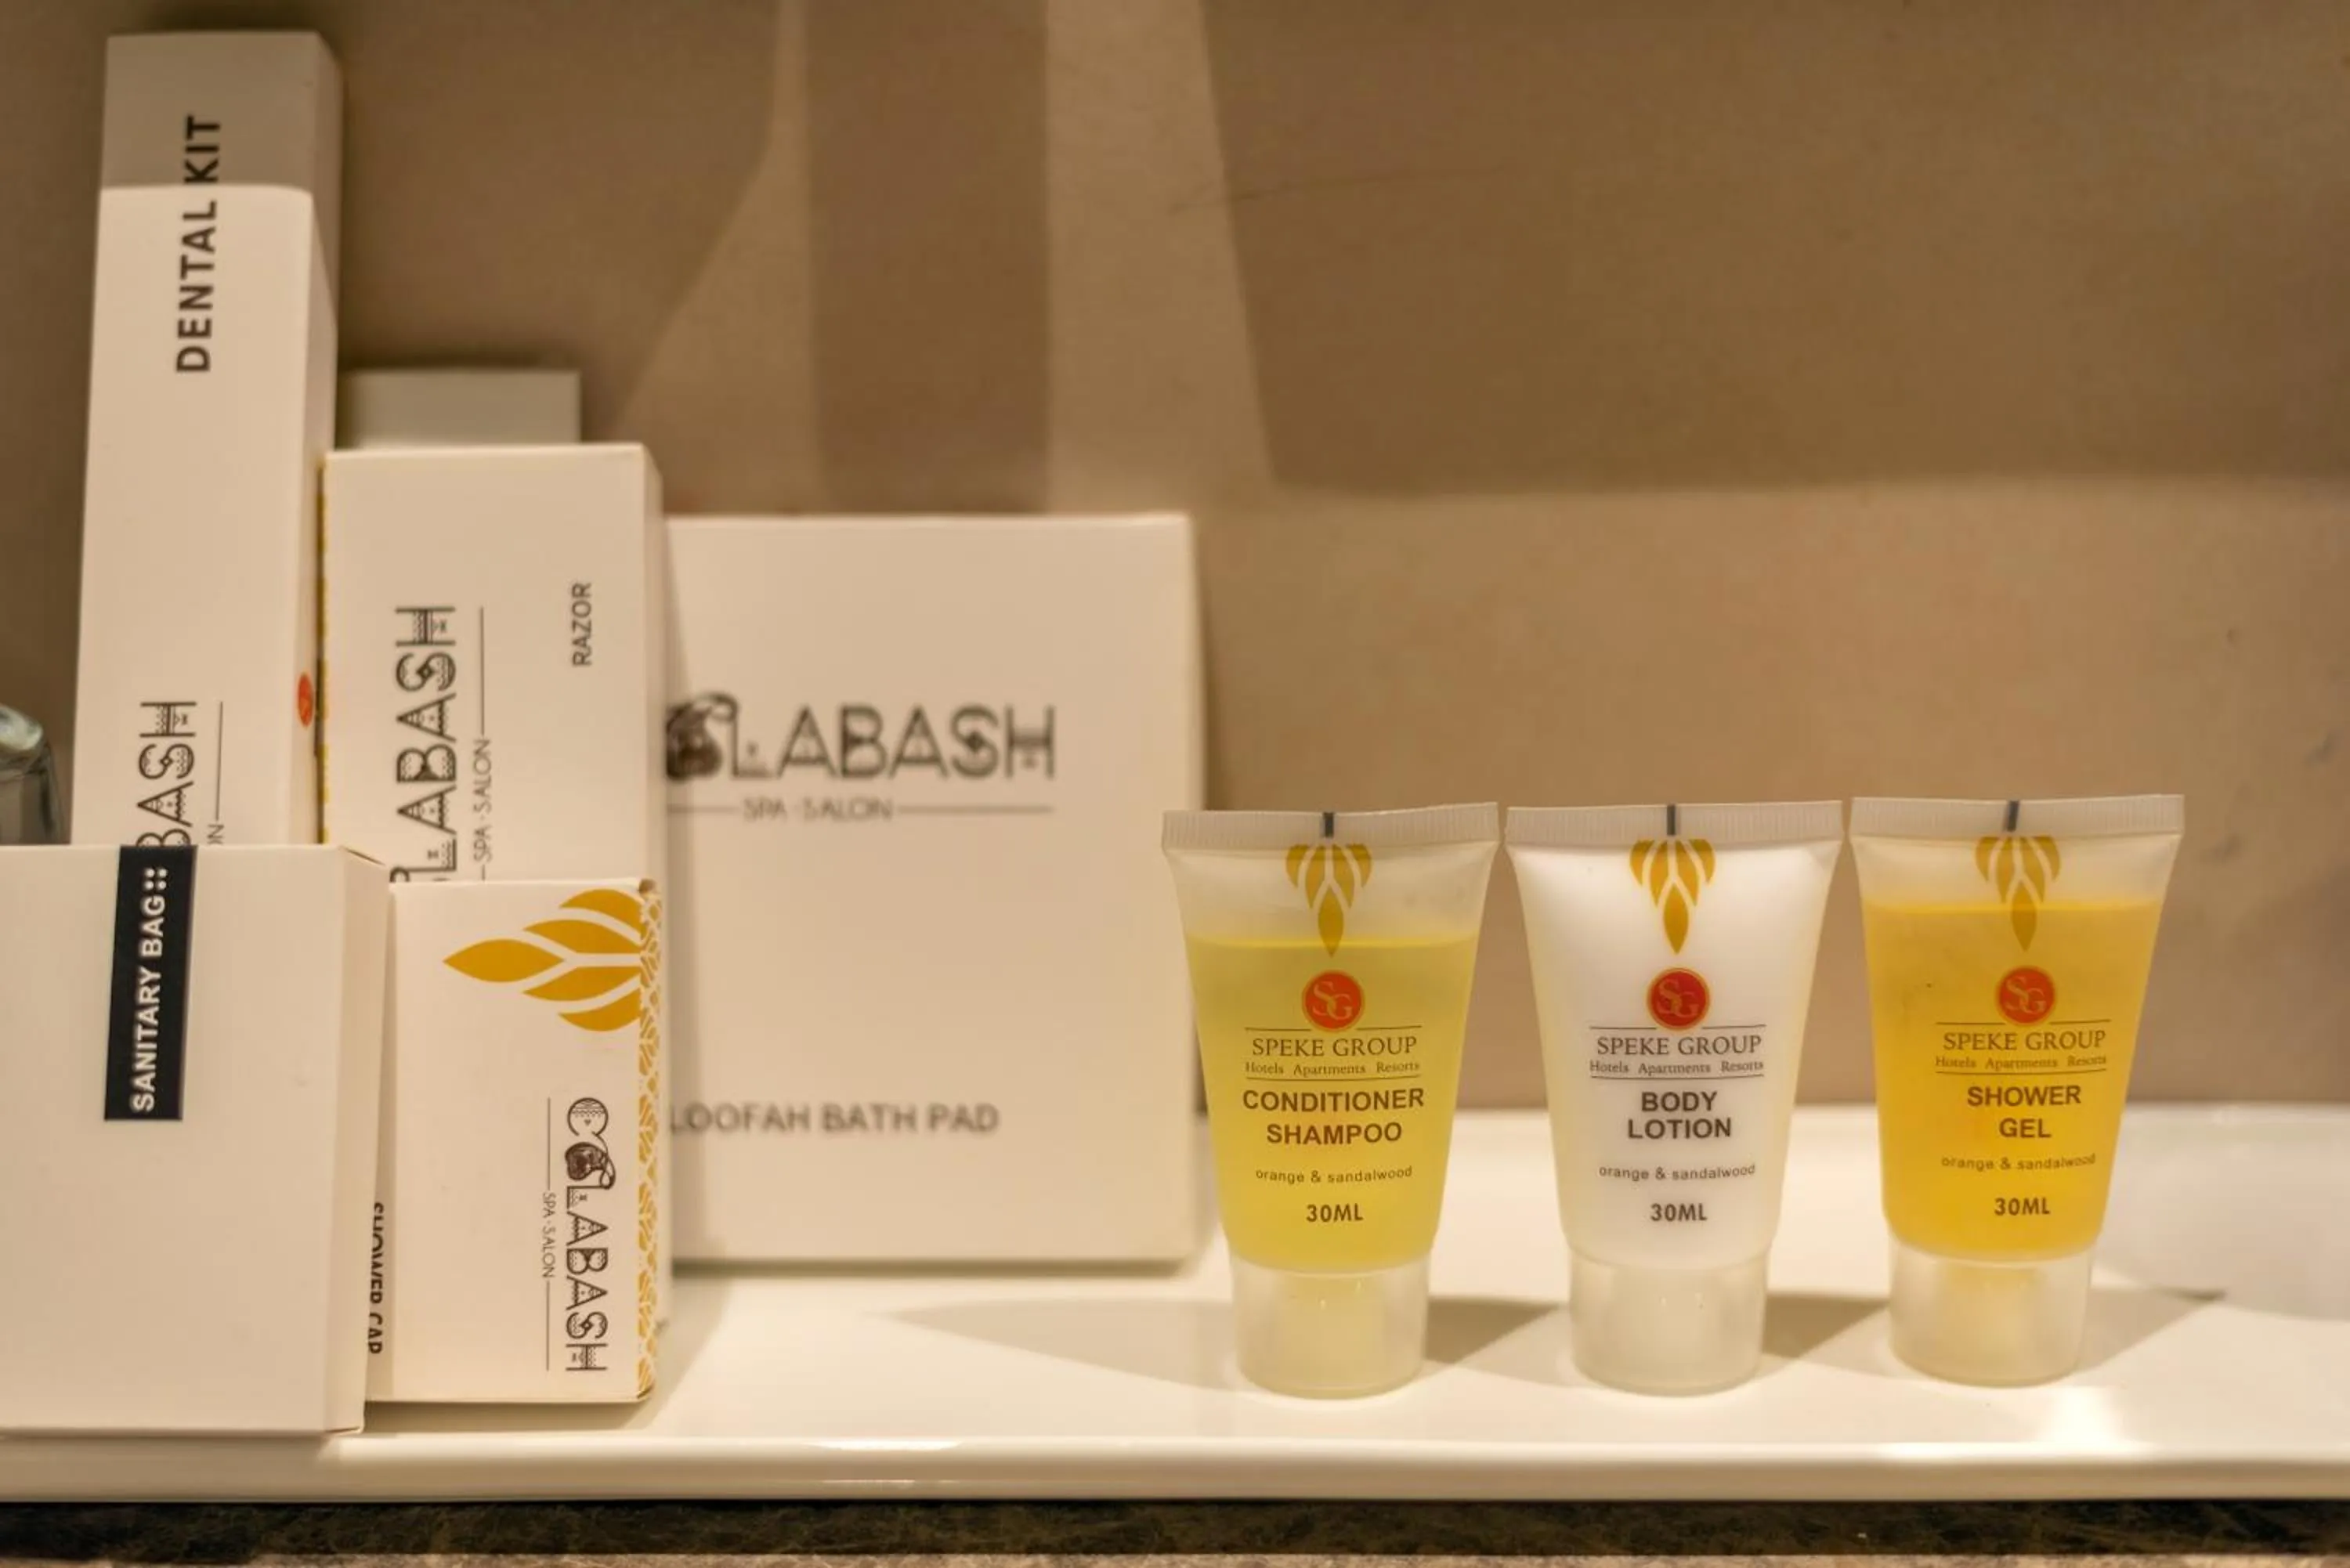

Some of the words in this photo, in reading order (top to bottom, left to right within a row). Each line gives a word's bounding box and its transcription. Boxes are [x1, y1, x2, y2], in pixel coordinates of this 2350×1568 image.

[183, 114, 221, 183] KIT
[175, 201, 217, 373] DENTAL
[571, 582, 592, 667] RAZOR
[389, 605, 457, 882] LABASH
[472, 739, 492, 813] SALON
[472, 825, 492, 862] SPA
[140, 895, 166, 958] BAG
[132, 966, 162, 1112] SANITARY
[1253, 1039, 1325, 1057] SPEKE
[1332, 1036, 1418, 1057] GROUP
[1597, 1036, 1669, 1056] SPEKE
[1677, 1035, 1762, 1055] GROUP
[1943, 1032, 2017, 1050] SPEKE
[2025, 1030, 2106, 1050] GROUP
[1246, 1062, 1284, 1075] Hotels
[1293, 1063, 1366, 1077] Apartments
[1376, 1060, 1420, 1074] Resorts
[1590, 1060, 1629, 1074] Hotels
[1638, 1061, 1711, 1076] Apartments
[1721, 1060, 1764, 1073] Resorts
[1936, 1056, 1976, 1068] Hotels
[1985, 1057, 2058, 1071] Apartments
[2068, 1055, 2106, 1067] Resorts
[1242, 1088, 1425, 1112] CONDITIONER
[1642, 1091, 1717, 1111] BODY
[1967, 1086, 2081, 1107] SHOWER
[669, 1102, 812, 1133] LOOFAH
[822, 1102, 917, 1133] BATH
[927, 1102, 1000, 1133] PAD
[1999, 1118, 2052, 1138] GEL
[1267, 1122, 1402, 1144] SHAMPOO
[1629, 1118, 1731, 1140] LOTION
[1599, 1166, 1649, 1182] orange
[1655, 1167, 1666, 1180] &
[1672, 1164, 1755, 1180] sandalwood
[1941, 1156, 1994, 1172] orange
[2000, 1157, 2011, 1169] &
[2017, 1154, 2095, 1169] sandalwood
[1256, 1169, 1304, 1184] orange
[1311, 1170, 1321, 1183] &
[1328, 1165, 1412, 1183] sandalwood
[542, 1191, 556, 1218] SPA
[1306, 1204, 1363, 1222] 30ML
[1650, 1203, 1708, 1222] 30ML
[1995, 1198, 2050, 1216] 30ML
[541, 1227, 556, 1279] SALON
